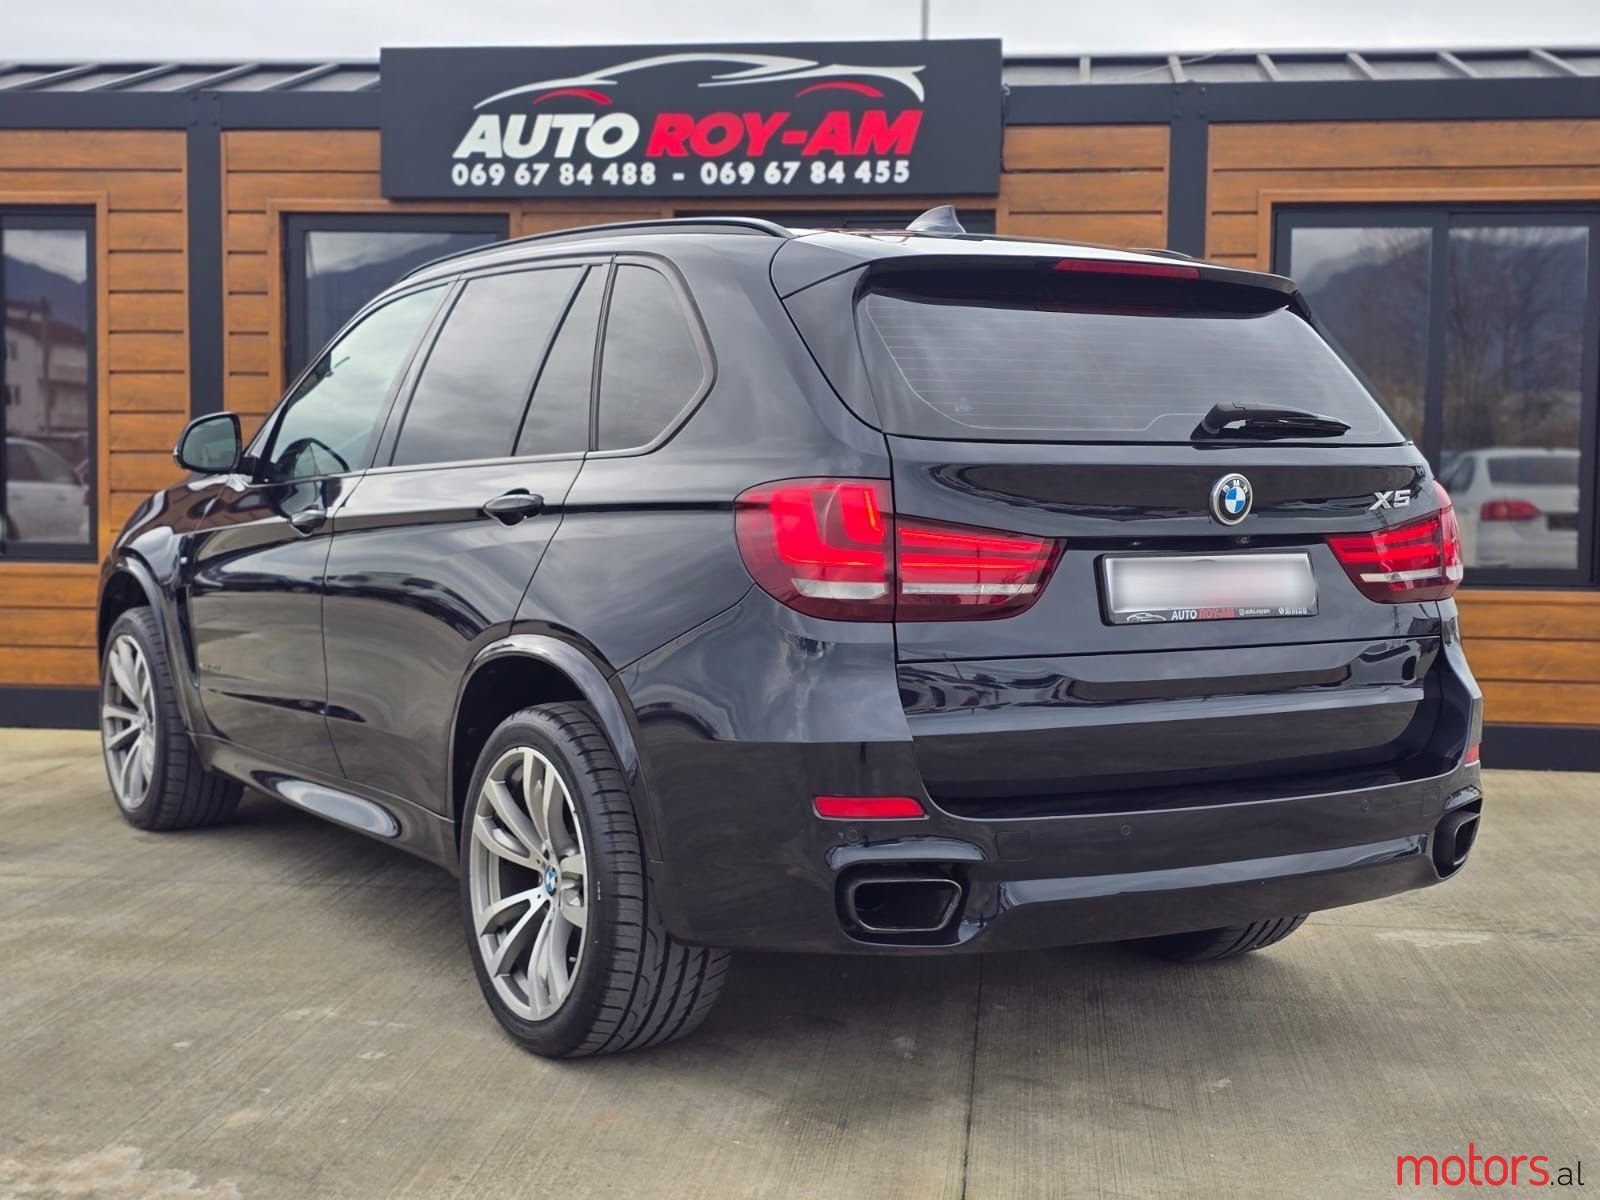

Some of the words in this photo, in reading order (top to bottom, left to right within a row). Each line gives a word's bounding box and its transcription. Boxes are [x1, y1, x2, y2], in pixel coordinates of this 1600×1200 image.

[452, 112, 640, 159] AUTO
[645, 110, 924, 158] ROY-AM
[452, 163, 505, 186] 069
[514, 163, 550, 186] 67
[559, 162, 594, 186] 84
[602, 162, 656, 186] 488
[700, 161, 755, 185] 069
[764, 161, 801, 185] 67
[810, 161, 846, 184] 84
[854, 160, 910, 184] 455
[1369, 489, 1411, 510] X5
[1171, 609, 1198, 621] AUTO
